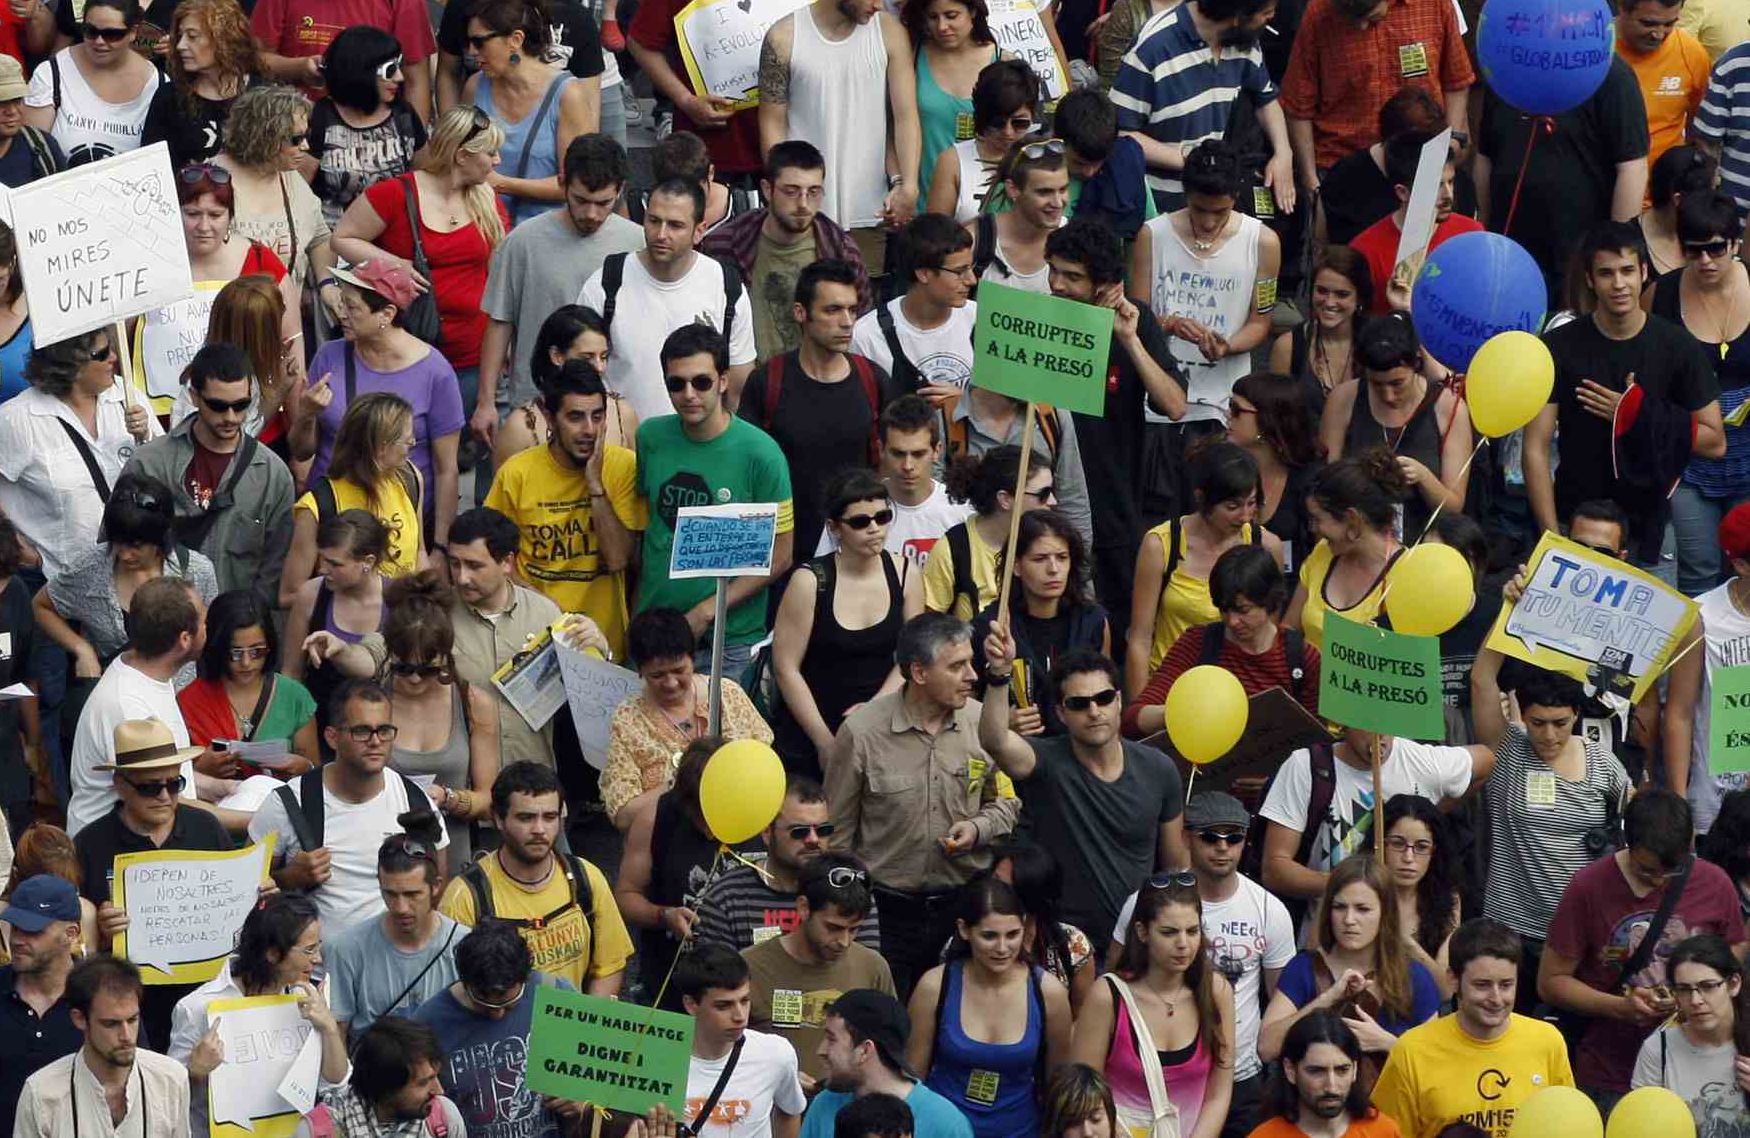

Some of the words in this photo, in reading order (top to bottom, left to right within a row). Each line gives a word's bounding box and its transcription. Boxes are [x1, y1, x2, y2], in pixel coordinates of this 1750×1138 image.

[28, 228, 48, 248] NO
[57, 218, 89, 237] NOS
[46, 240, 112, 275] MIRES
[57, 267, 149, 314] ÚNETE
[159, 306, 178, 325] SU
[989, 312, 1096, 351] CORRUPTES
[986, 339, 1000, 356] A
[1004, 345, 1028, 365] LA
[1033, 352, 1094, 379] PRESÓ
[663, 485, 709, 506] STOP
[530, 520, 581, 542] TOMA
[1549, 555, 1655, 616] TOMA
[1330, 642, 1426, 679] CORRUPTES
[1329, 670, 1341, 686] A
[1343, 677, 1363, 695] LA
[1366, 683, 1429, 707] PRESÓ
[545, 1004, 574, 1022] PER
[576, 1010, 599, 1025] UN
[600, 1016, 685, 1043] HABITATGE
[576, 1042, 632, 1065] DIGNE
[635, 1054, 643, 1068] I
[543, 1057, 673, 1097] GARANTITZAT
